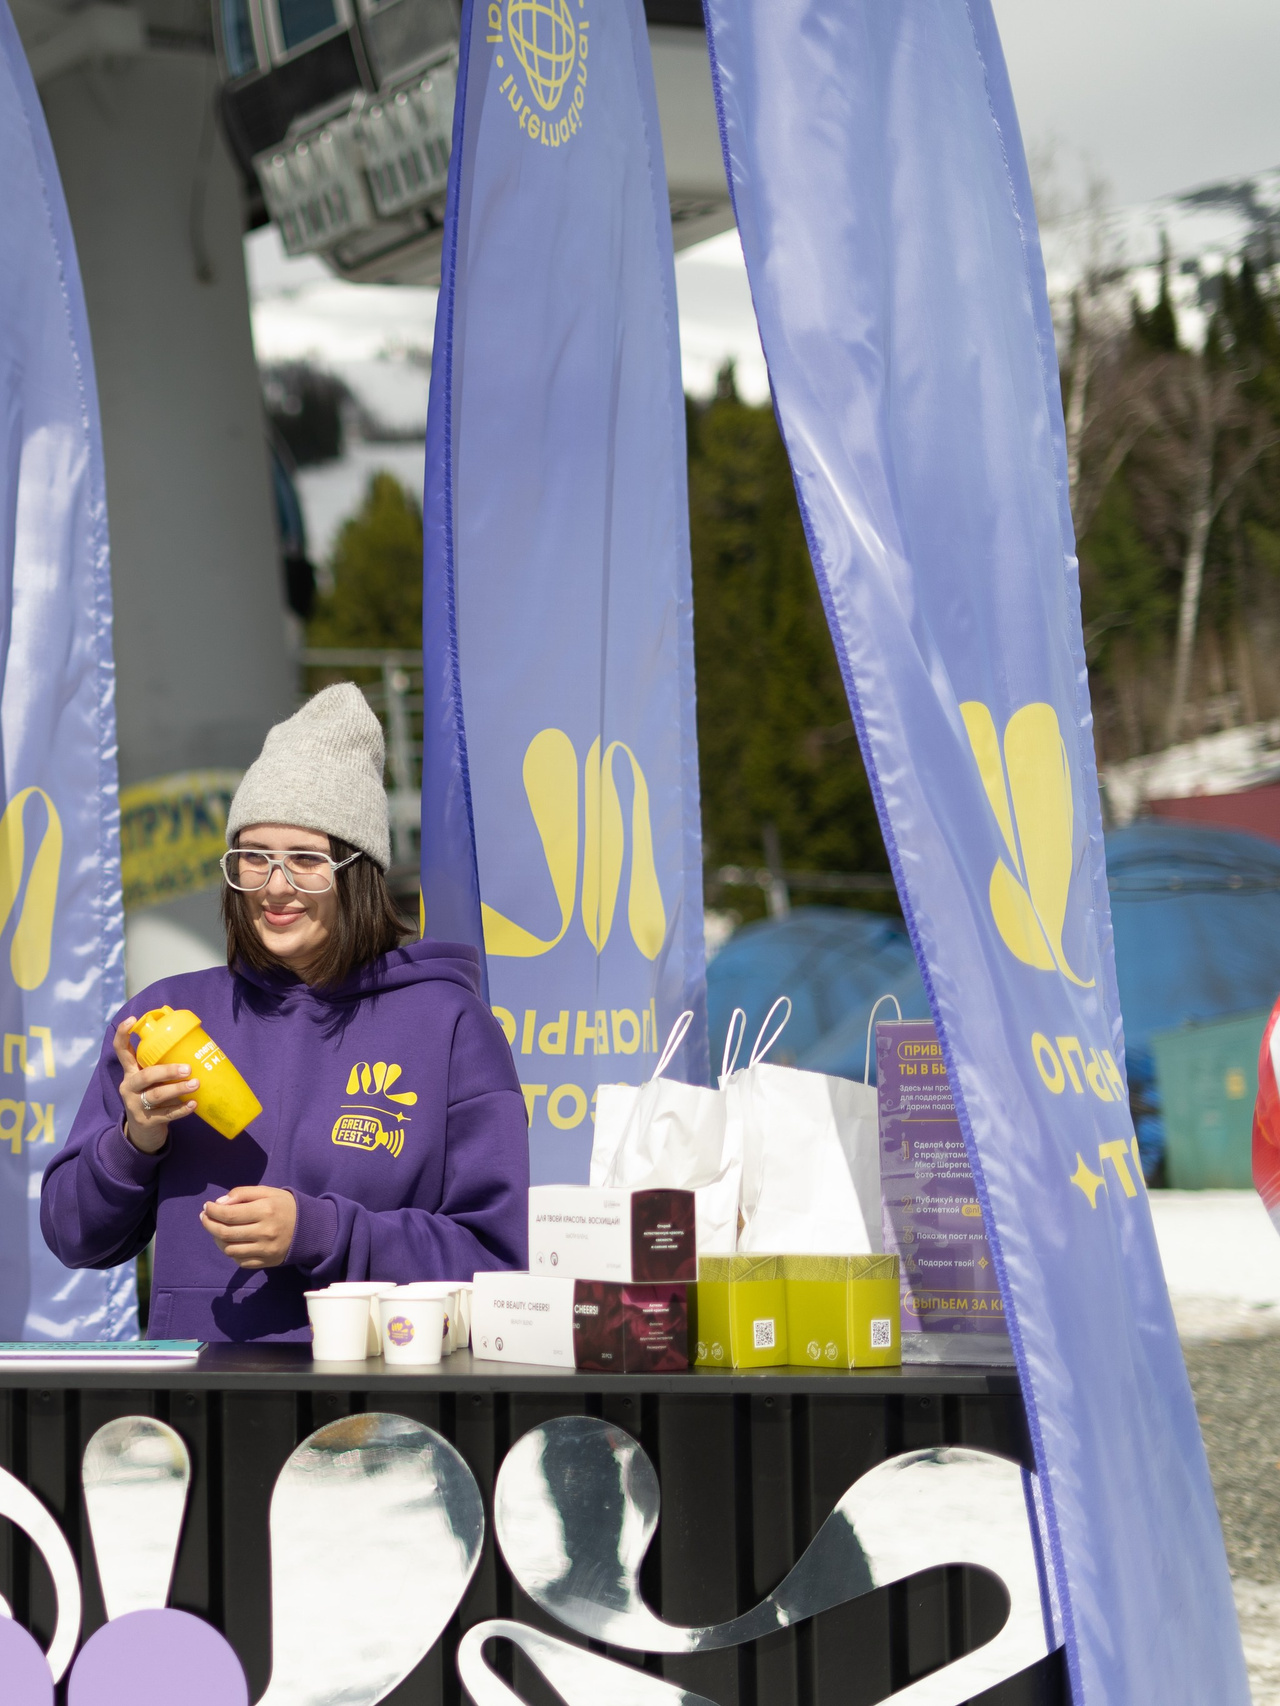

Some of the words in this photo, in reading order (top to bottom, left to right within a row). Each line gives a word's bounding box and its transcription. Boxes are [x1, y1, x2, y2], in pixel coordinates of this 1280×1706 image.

[904, 1045, 943, 1056] ПРИВ
[899, 1064, 917, 1075] ТЫ
[921, 1064, 928, 1075] В
[914, 1094, 953, 1102] поддержа
[340, 1118, 377, 1134] GRELKA
[337, 1130, 363, 1143] FEST
[914, 1141, 943, 1150] Сделай
[944, 1141, 965, 1150] фото
[914, 1171, 973, 1179] фото-табличк
[915, 1196, 953, 1204] Публикуй
[918, 1259, 953, 1268] Подарок
[493, 1299, 505, 1309] FOR
[527, 1302, 550, 1312] CHEERS!
[574, 1304, 599, 1315] CHEERS!
[912, 1298, 968, 1310] ВЫПЬЕМ
[971, 1299, 988, 1311] ЗА
